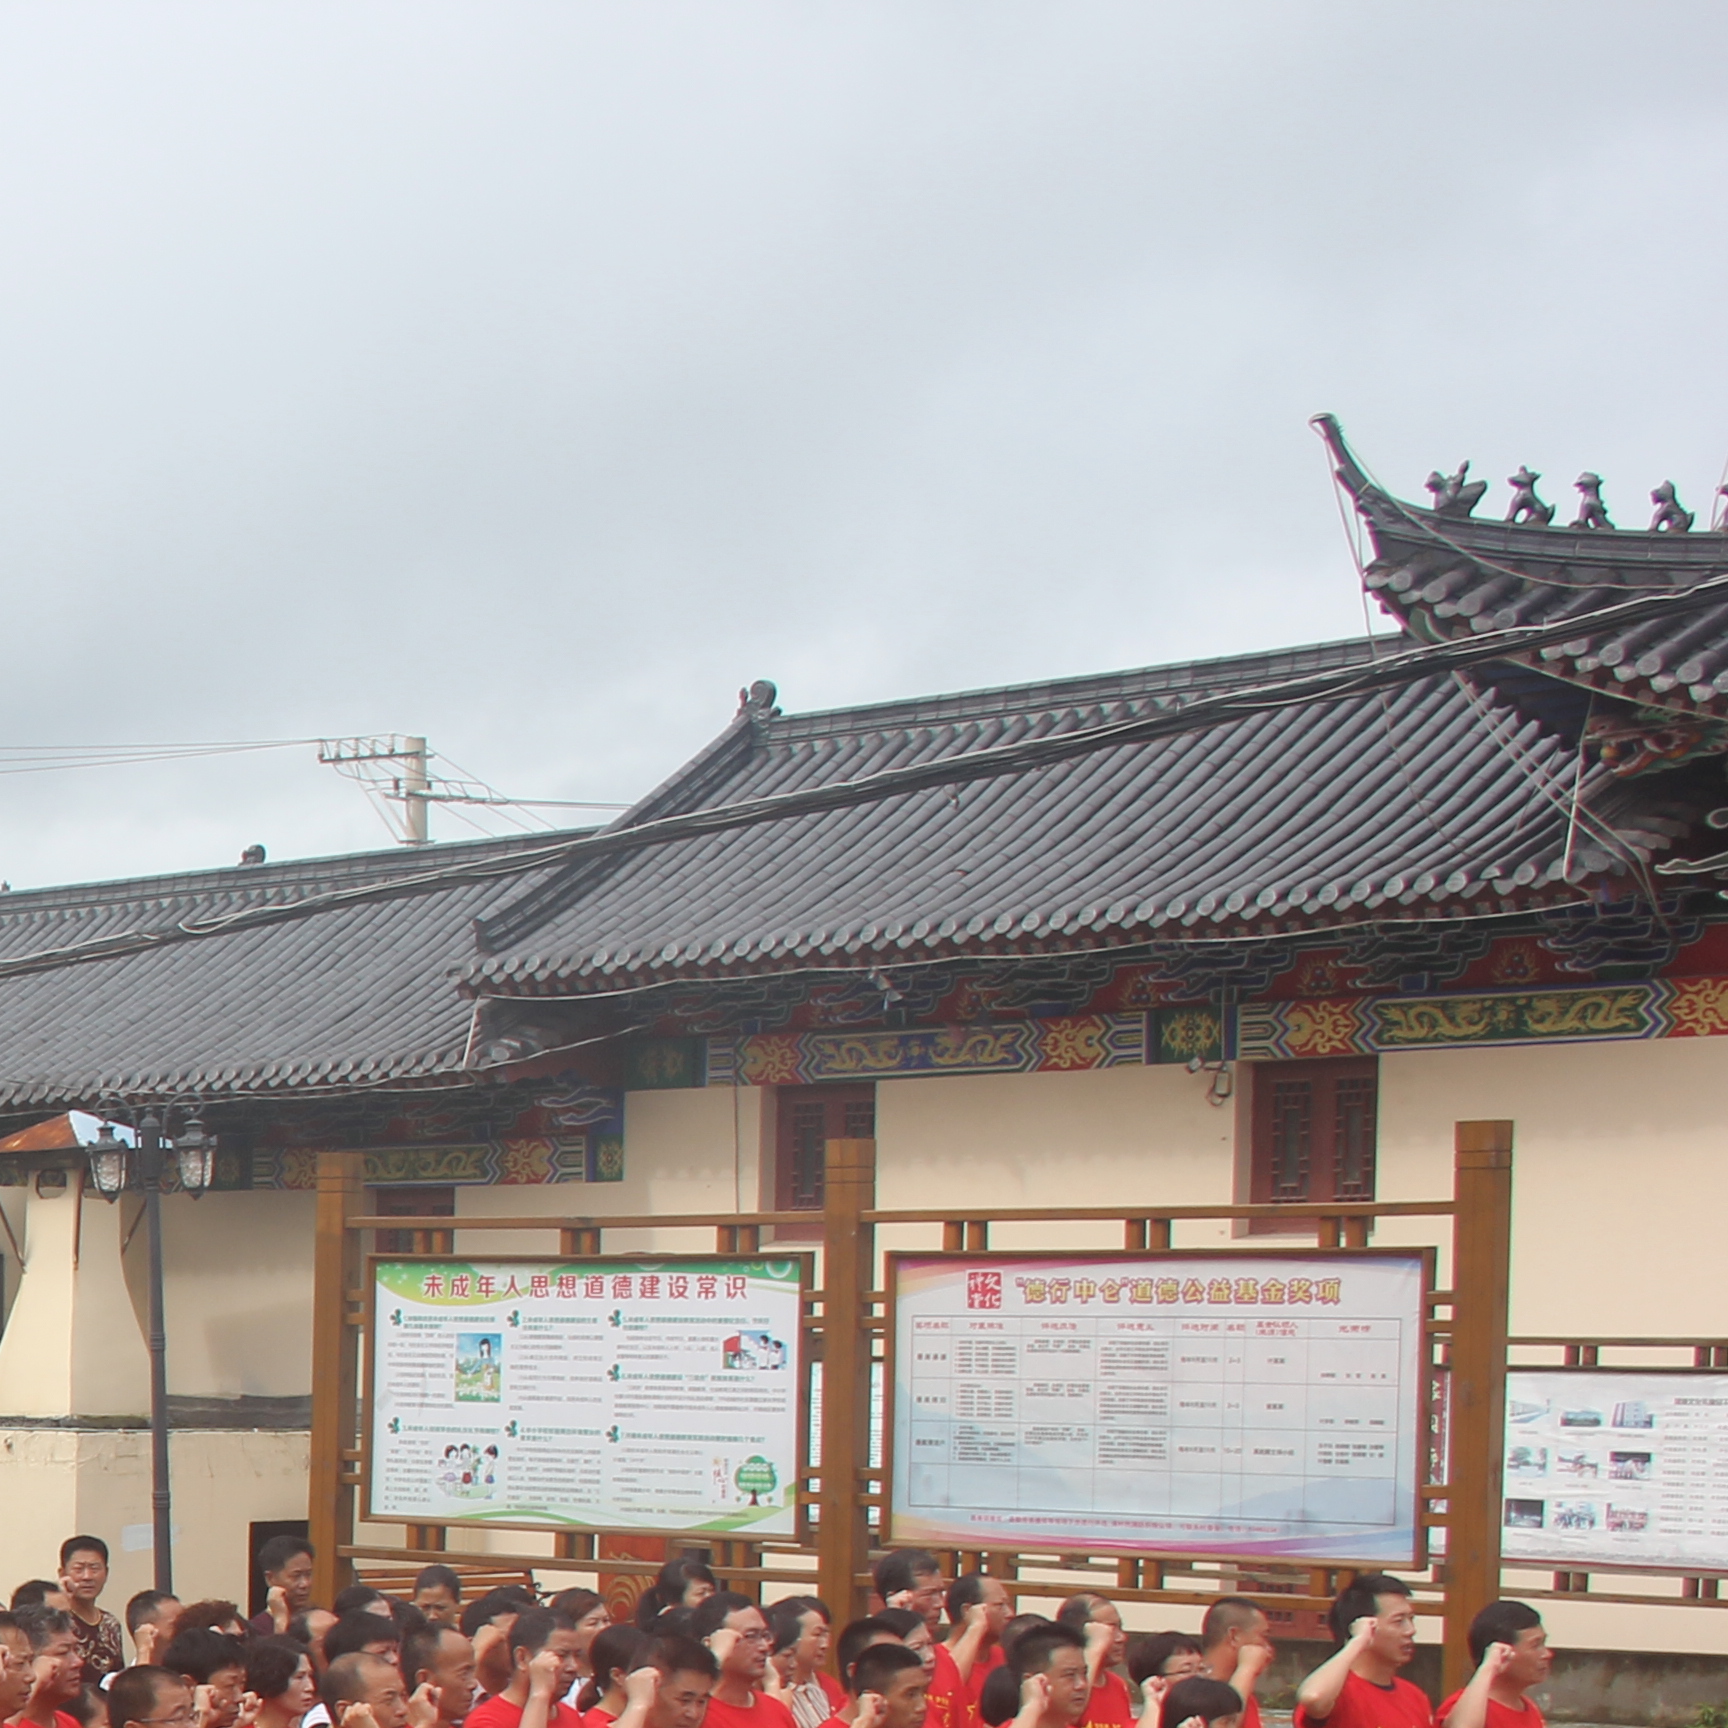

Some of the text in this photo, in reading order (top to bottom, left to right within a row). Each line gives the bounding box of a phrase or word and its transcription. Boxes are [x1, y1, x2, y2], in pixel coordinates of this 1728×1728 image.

[422, 1272, 750, 1300] 未成年人思想道德建设常识
